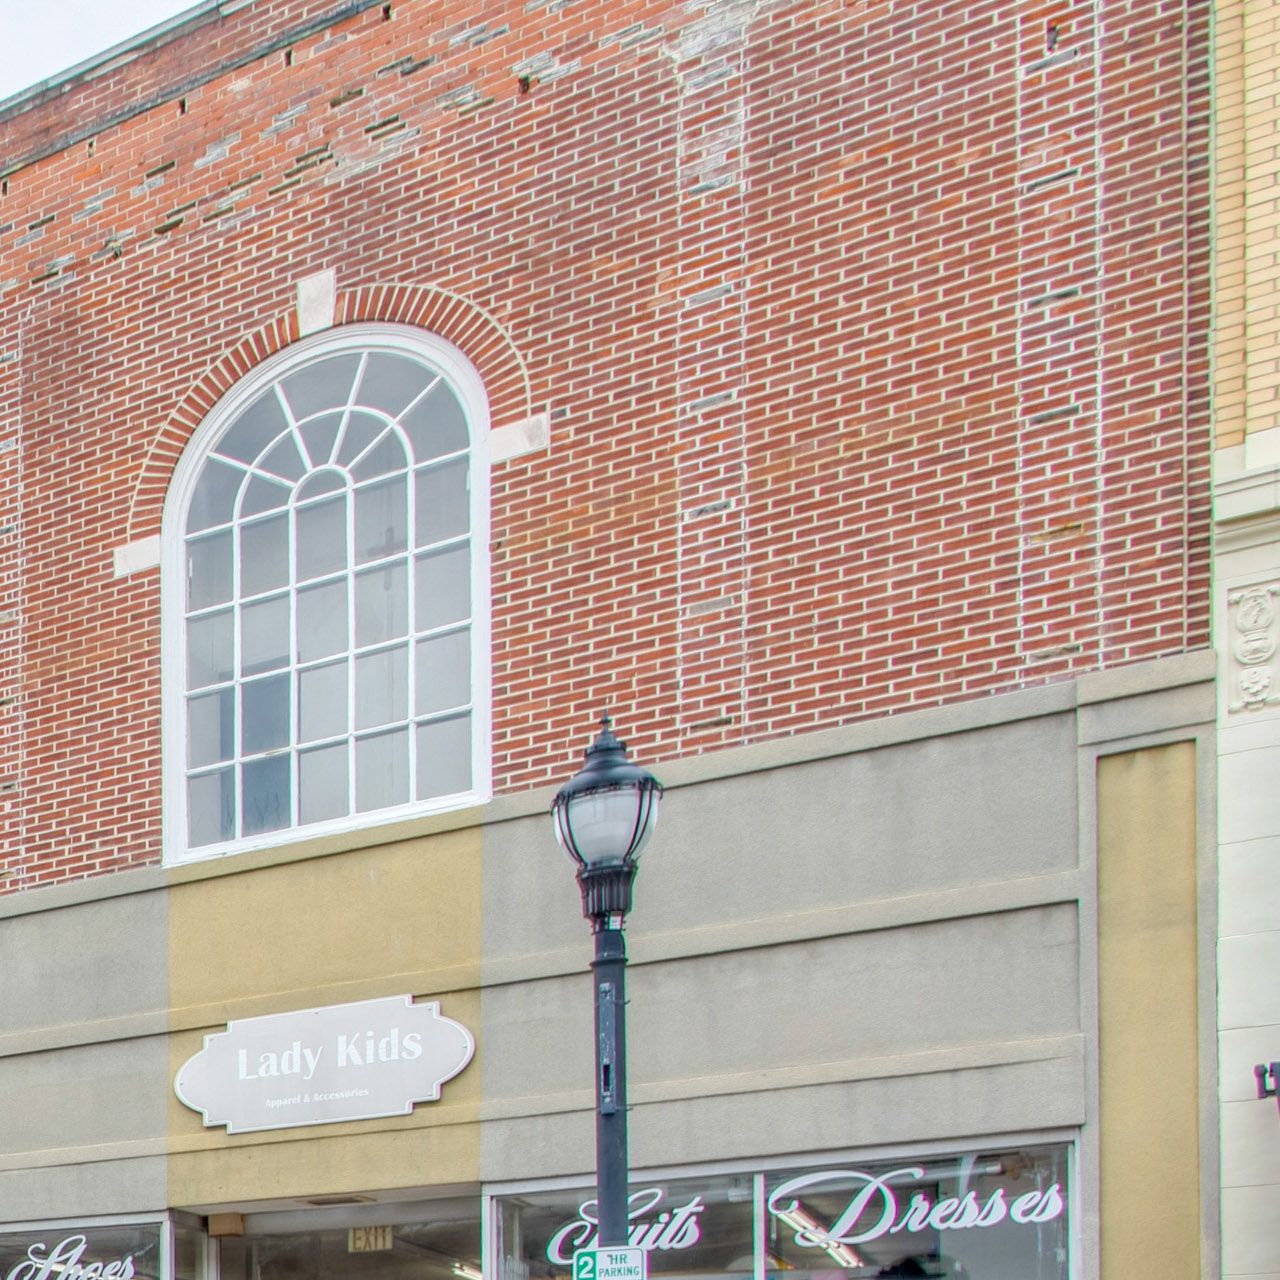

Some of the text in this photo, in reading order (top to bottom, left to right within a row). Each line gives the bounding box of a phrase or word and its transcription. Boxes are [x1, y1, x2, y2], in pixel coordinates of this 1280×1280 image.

[237, 1028, 424, 1080] Lady Kids
[265, 1087, 369, 1109] Apparel & Accessories
[767, 1166, 1064, 1248] Dresses
[352, 1227, 387, 1250] EXIT
[578, 1253, 628, 1278] 2 HR
[598, 1265, 640, 1277] PARKING
